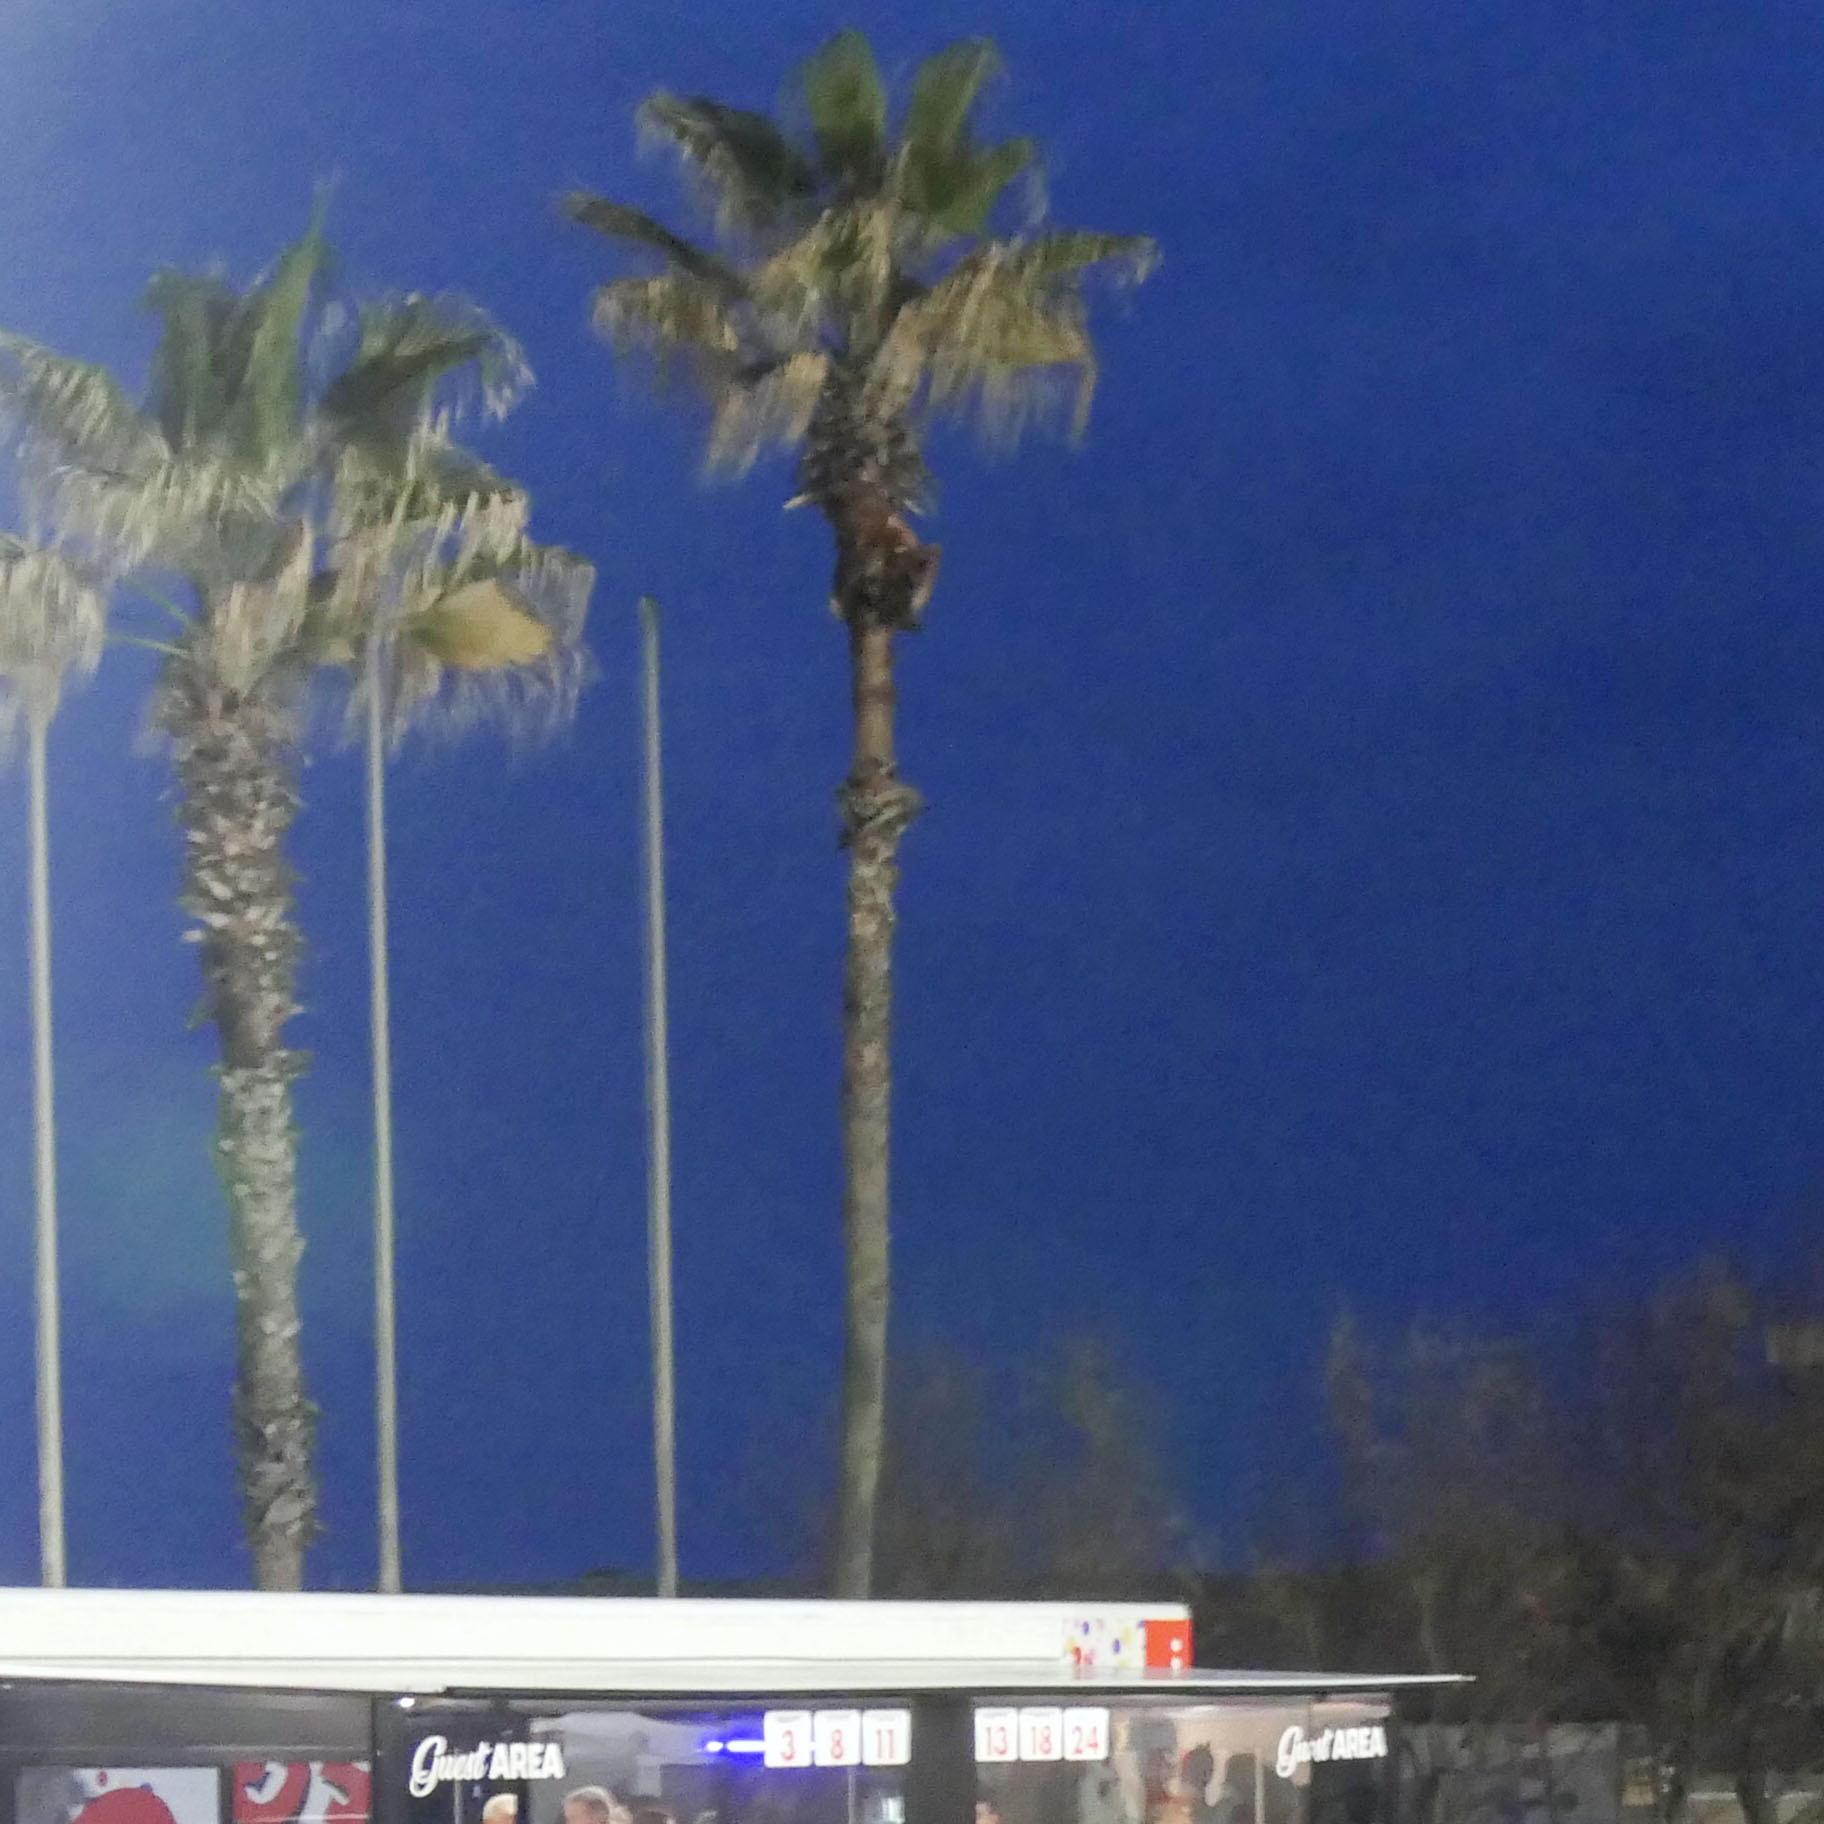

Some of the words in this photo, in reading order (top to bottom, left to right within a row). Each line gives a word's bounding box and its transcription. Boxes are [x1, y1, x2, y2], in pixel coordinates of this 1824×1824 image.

[780, 1729, 796, 1761] 3
[830, 1728, 845, 1760] 8
[875, 1728, 896, 1759] 11
[984, 1726, 1008, 1756] 13
[1030, 1725, 1052, 1755] 18
[1071, 1725, 1099, 1755] 24
[1332, 1727, 1388, 1760] AREA
[409, 1735, 493, 1798] Guest
[488, 1742, 566, 1779] AREA
